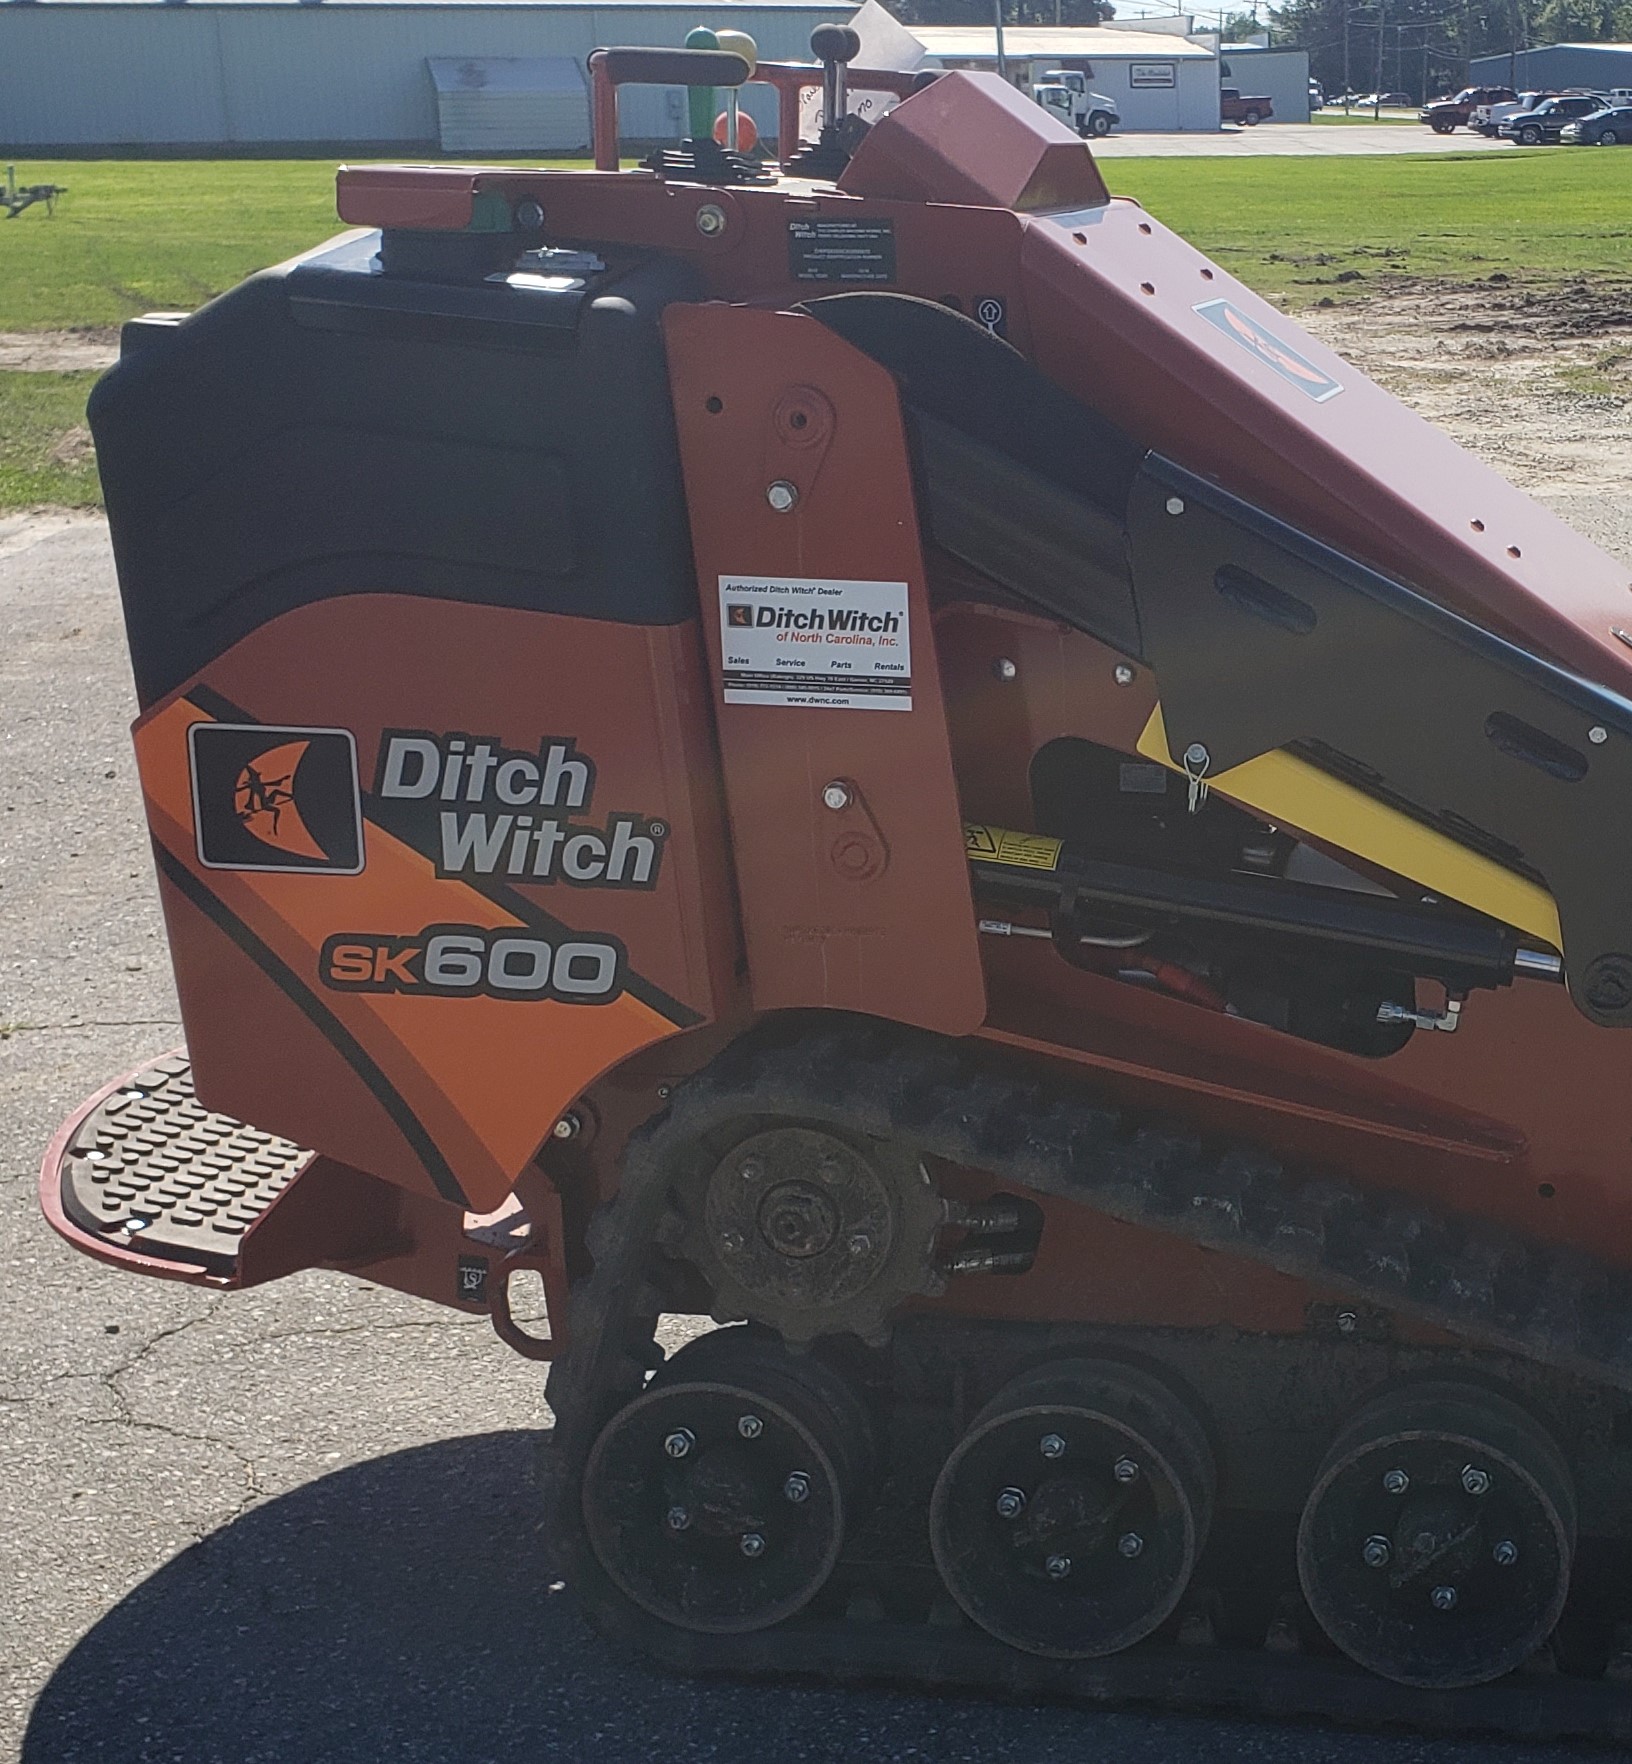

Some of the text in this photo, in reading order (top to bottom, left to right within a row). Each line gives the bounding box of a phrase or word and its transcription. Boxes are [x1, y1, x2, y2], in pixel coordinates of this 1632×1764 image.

[725, 583, 768, 593] Authorized
[769, 585, 790, 595] Ditch
[817, 588, 843, 597] Dealer
[776, 632, 900, 648] of North Carolina, Inc.
[728, 656, 906, 672] Sales Service Parts Rentals
[786, 695, 850, 706] www.dwnc.com
[381, 737, 590, 808] Ditch
[329, 935, 618, 994] SK600
